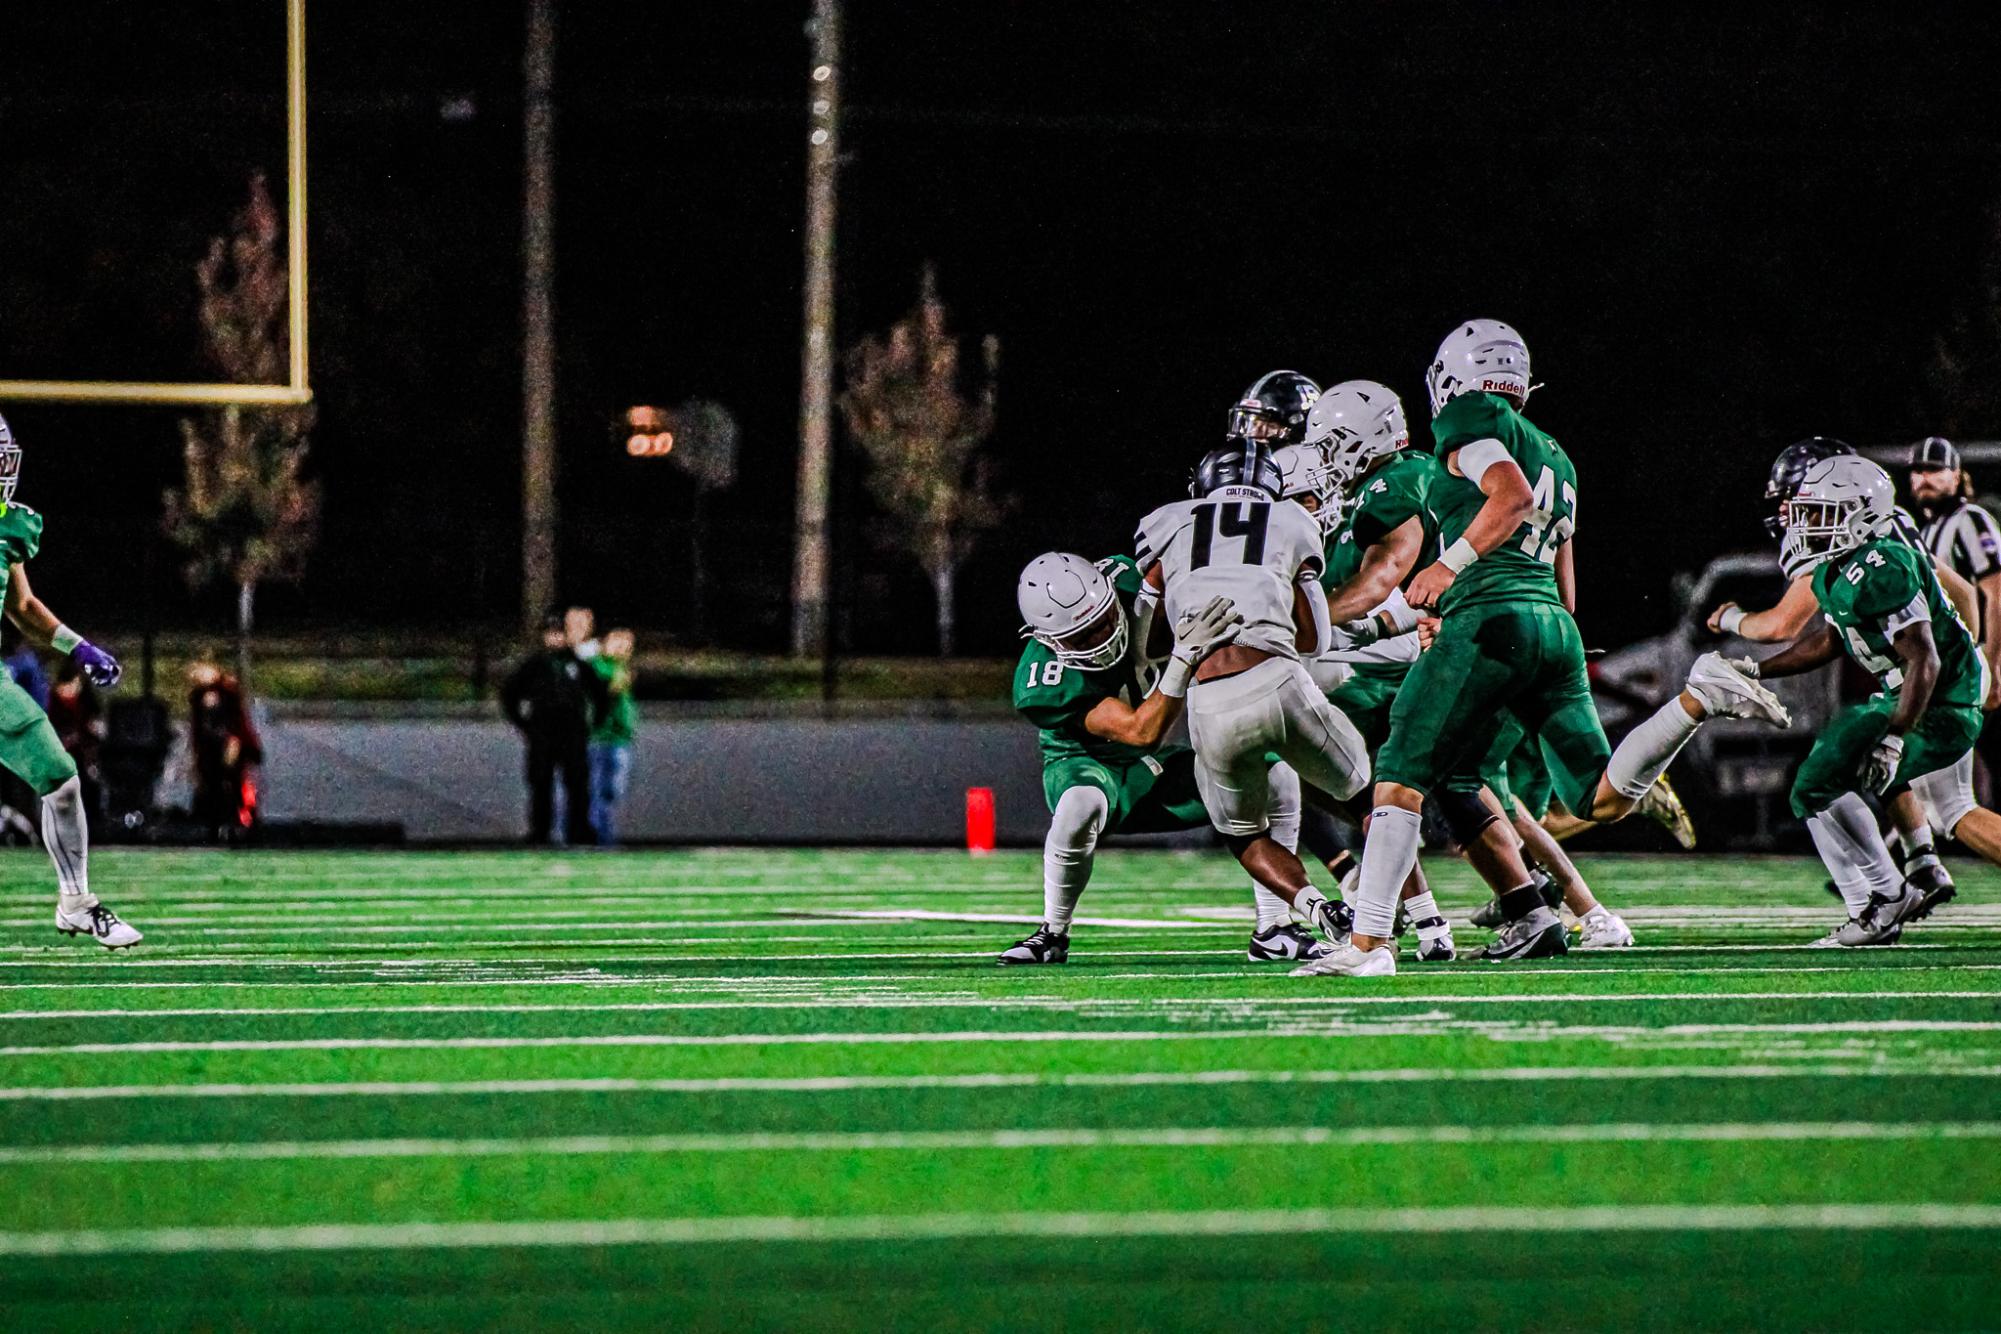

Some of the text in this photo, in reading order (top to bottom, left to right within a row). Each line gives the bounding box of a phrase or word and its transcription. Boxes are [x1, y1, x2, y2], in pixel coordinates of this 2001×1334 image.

[1483, 379, 1526, 396] Riddell
[1226, 488, 1241, 496] COLT
[1519, 464, 1577, 566] 42
[1190, 502, 1271, 572] 14
[1845, 549, 1886, 585] 54
[1026, 660, 1064, 688] 18
